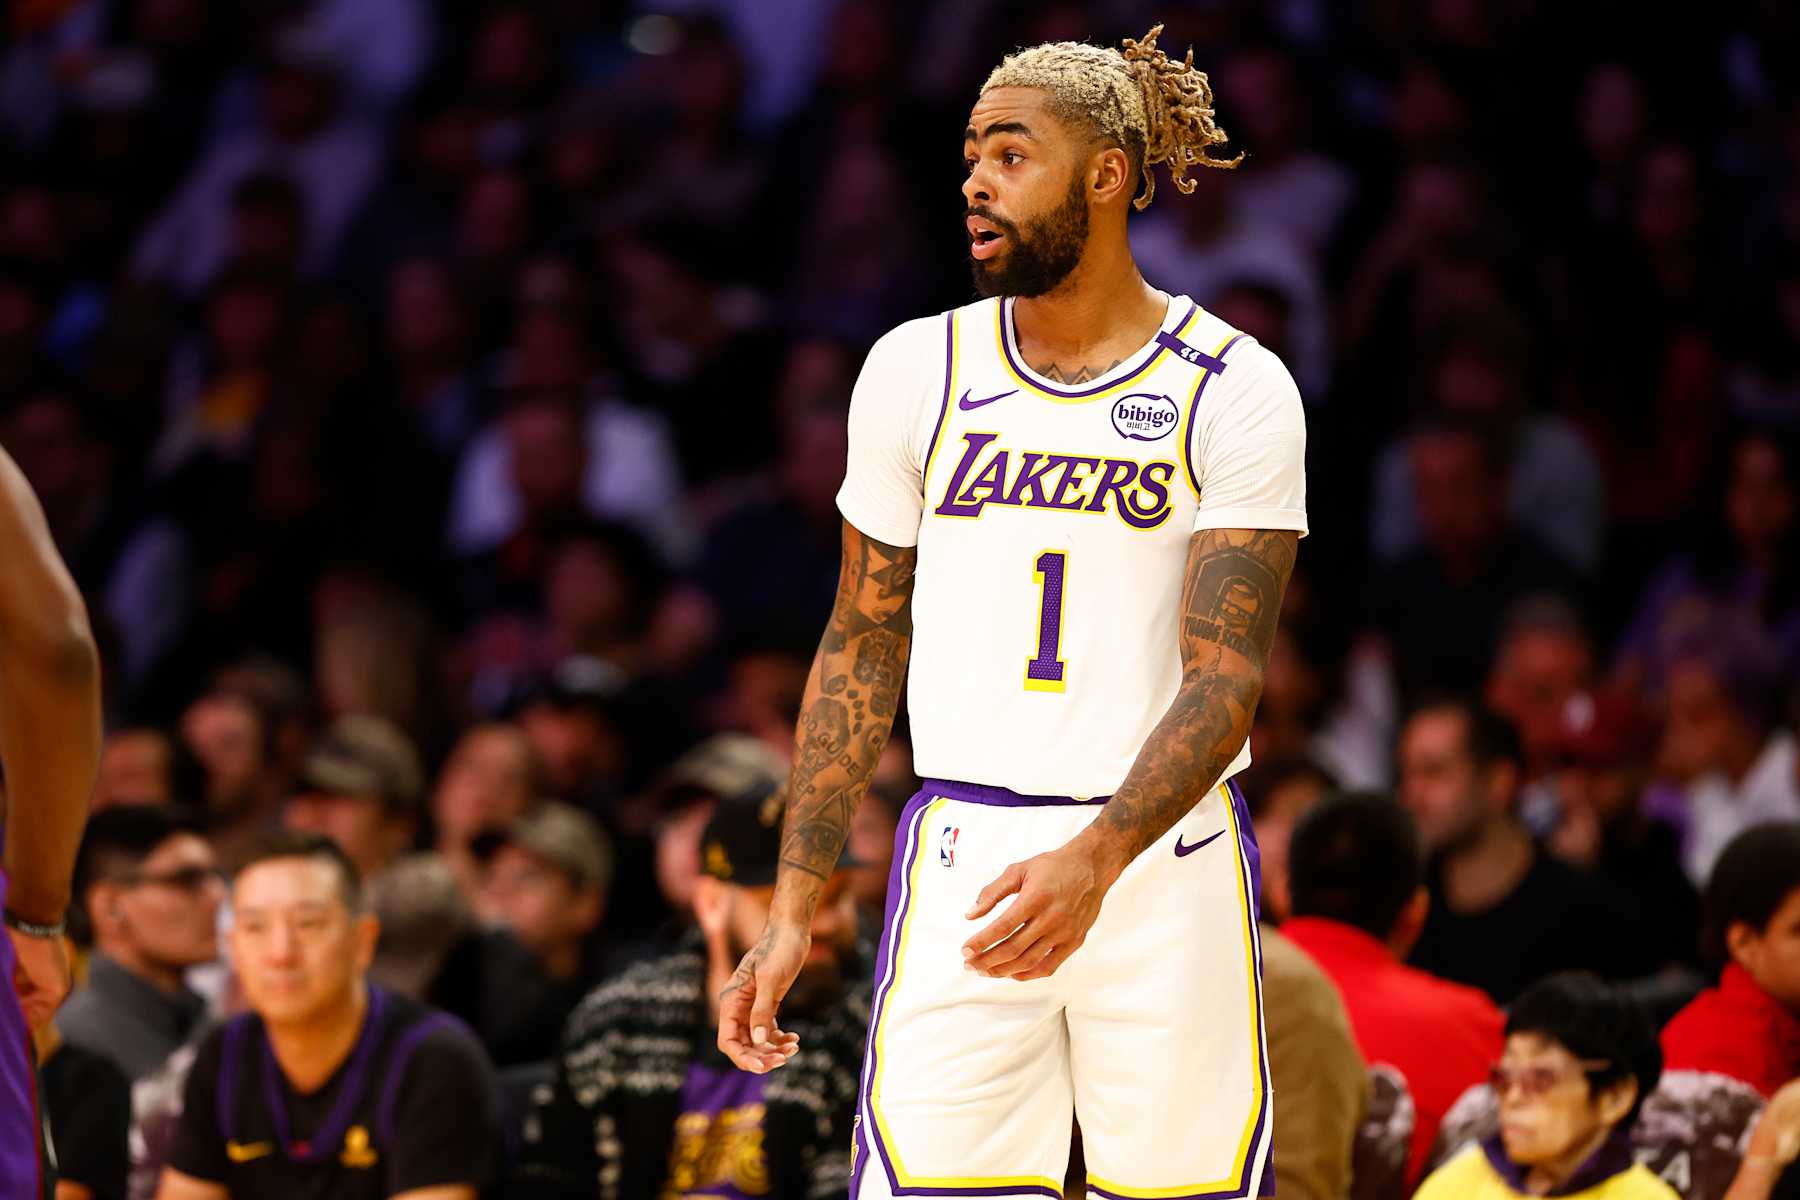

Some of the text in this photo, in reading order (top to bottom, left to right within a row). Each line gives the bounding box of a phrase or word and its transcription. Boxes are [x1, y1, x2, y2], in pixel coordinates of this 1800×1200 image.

[1180, 347, 1200, 362] 44
[1118, 404, 1175, 428] bibigo
[933, 431, 1177, 532] LAKERS
[1024, 549, 1068, 692] 1
[818, 732, 860, 777] GUIDE
